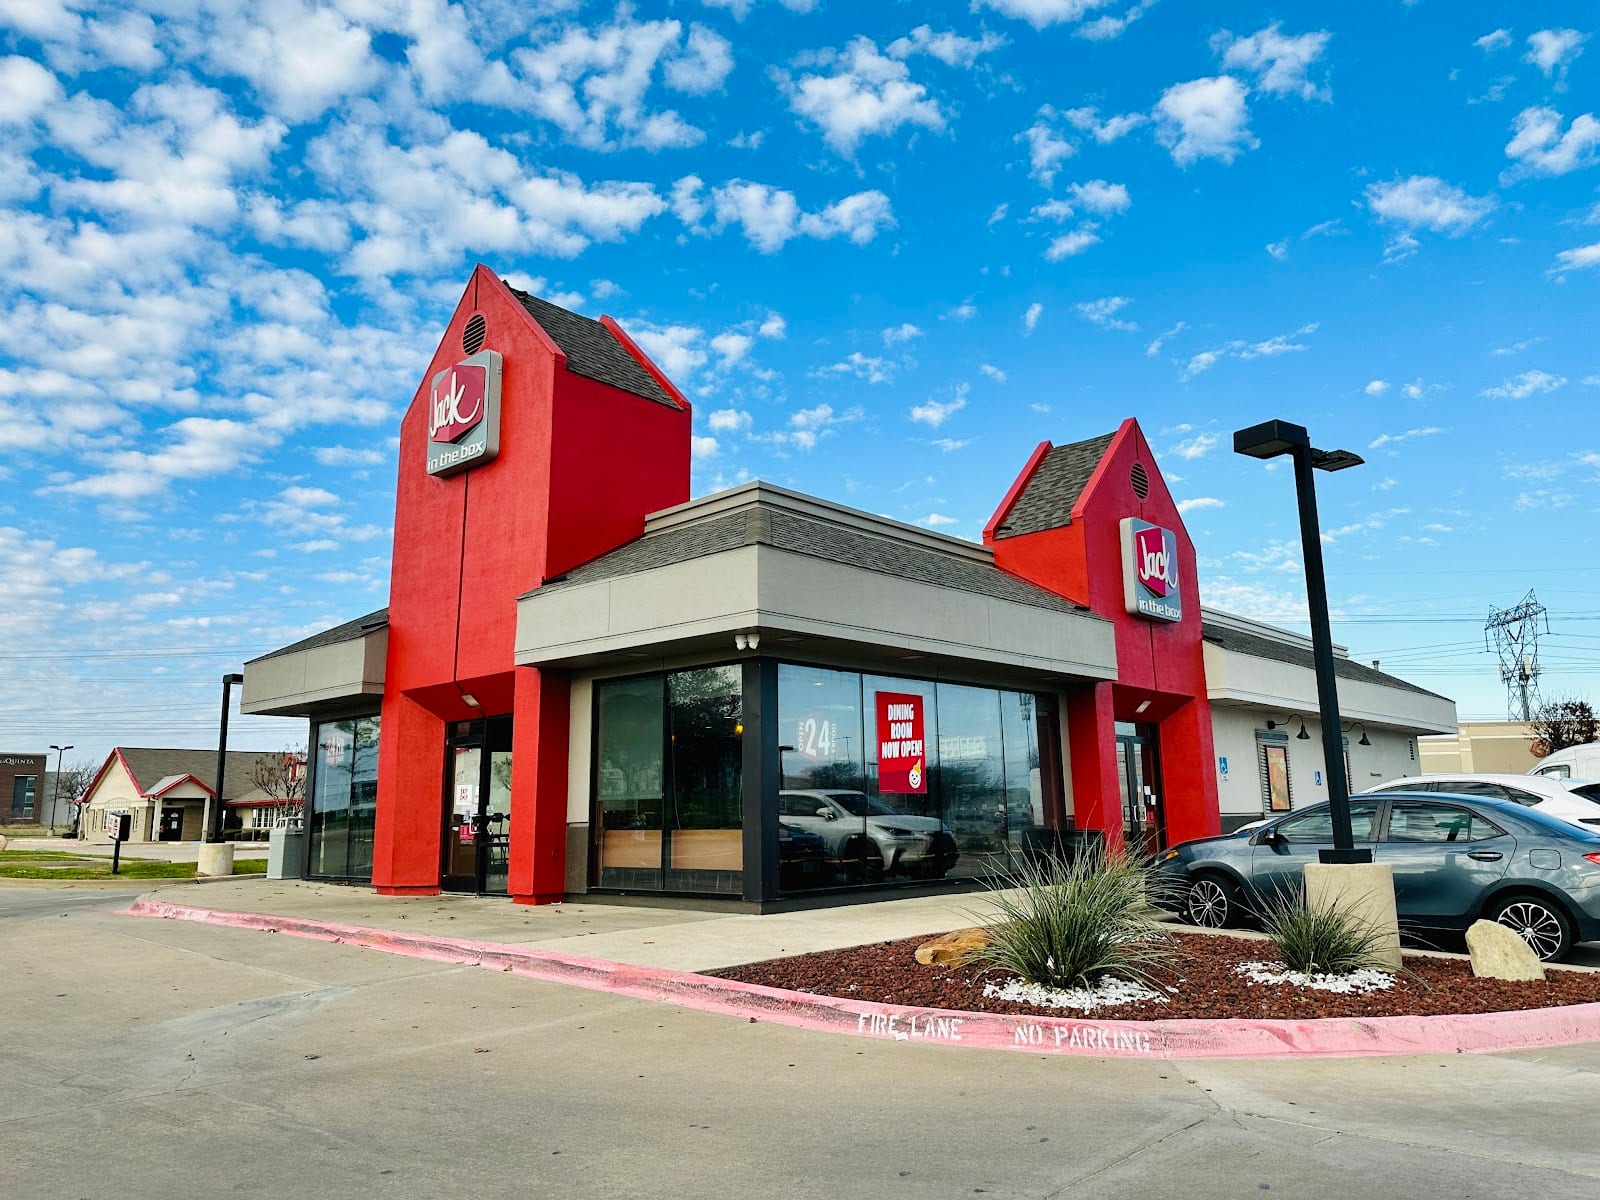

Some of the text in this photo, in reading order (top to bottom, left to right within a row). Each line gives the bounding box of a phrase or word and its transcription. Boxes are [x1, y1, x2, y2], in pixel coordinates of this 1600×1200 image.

[430, 371, 480, 437] Jack
[428, 441, 483, 471] in the box
[1139, 535, 1178, 588] Jack
[1139, 597, 1181, 617] in the box
[887, 704, 914, 720] DINING
[805, 718, 830, 756] 24
[890, 722, 913, 739] ROOM
[882, 740, 923, 758] NOW OPEN!
[857, 1012, 963, 1041] FIRE LANE
[1014, 1023, 1151, 1054] NO PARKING
